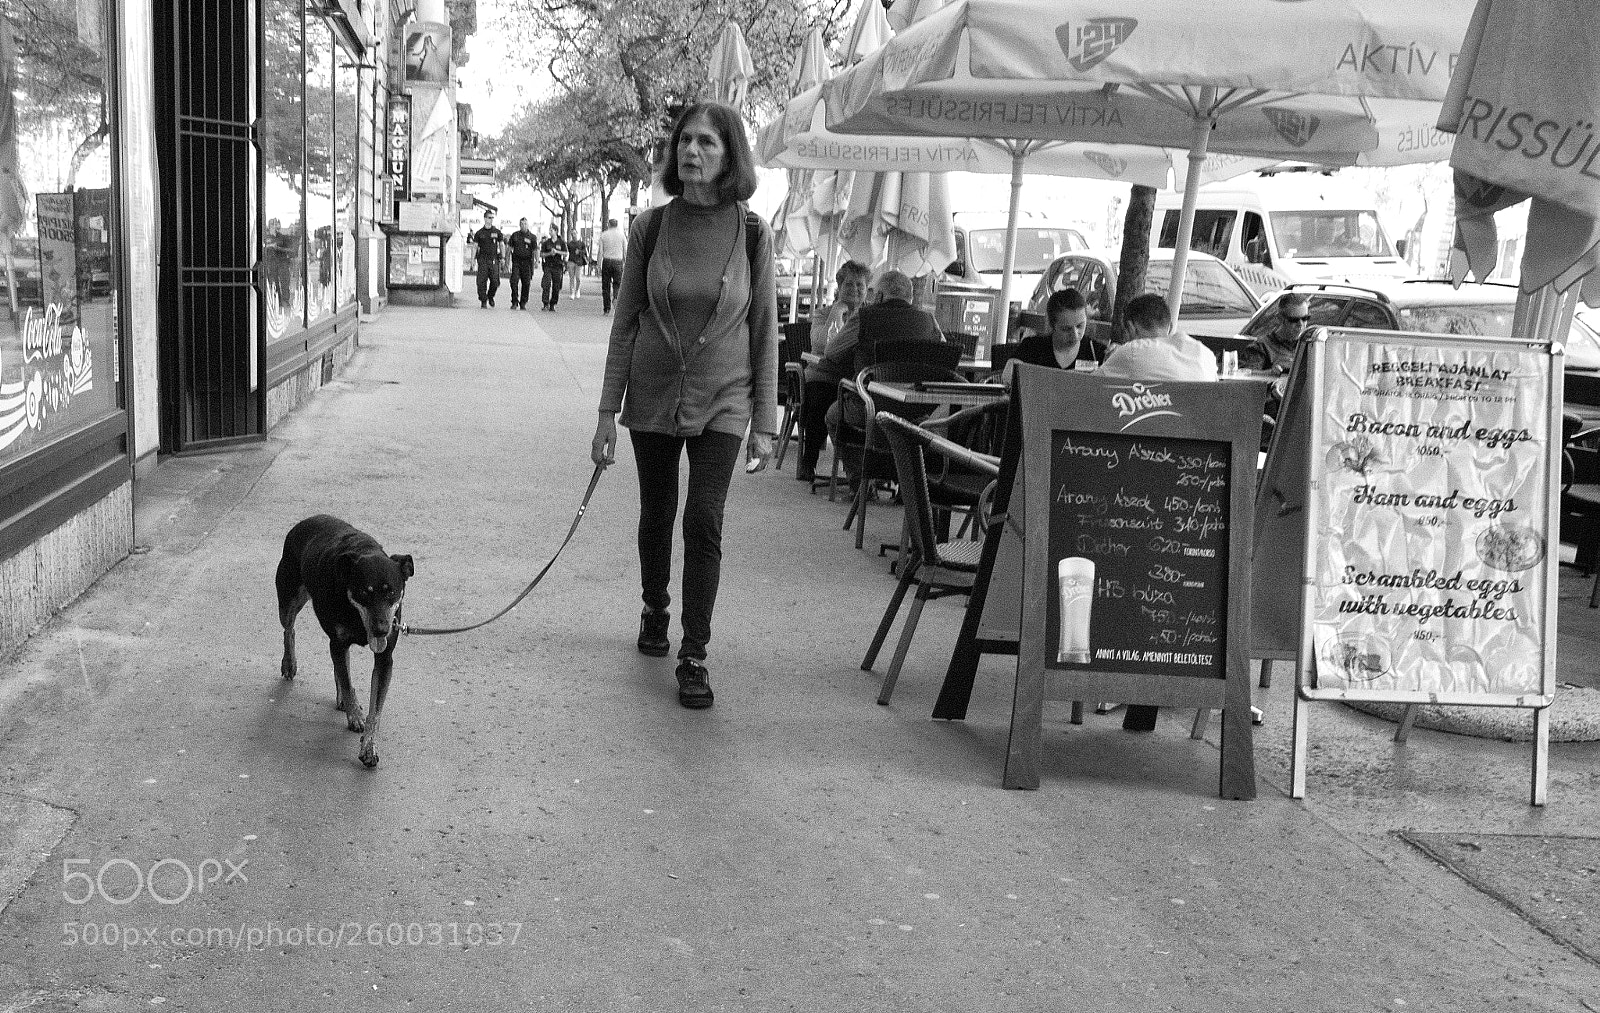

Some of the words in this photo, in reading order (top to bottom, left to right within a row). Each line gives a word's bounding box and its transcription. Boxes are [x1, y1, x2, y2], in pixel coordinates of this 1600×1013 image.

[1336, 41, 1437, 76] AKTÍV
[1396, 376, 1482, 391] BREAKFAST
[1438, 361, 1511, 381] AJÁNLAT
[1111, 389, 1173, 418] Dreher
[1346, 413, 1421, 437] Bacon
[1426, 420, 1471, 440] and
[1475, 427, 1532, 449] eggs
[1060, 437, 1119, 469] Arany
[1353, 484, 1410, 506] Ham
[1414, 489, 1459, 509] and
[1462, 497, 1518, 519] eggs
[1342, 565, 1463, 591] Scrambled
[1466, 577, 1524, 600] eggs
[1338, 594, 1390, 615] with
[1393, 598, 1519, 625] vegetables
[1095, 648, 1115, 660] ANNYI
[1116, 649, 1121, 660] A
[1142, 651, 1172, 664] AMENNYIT
